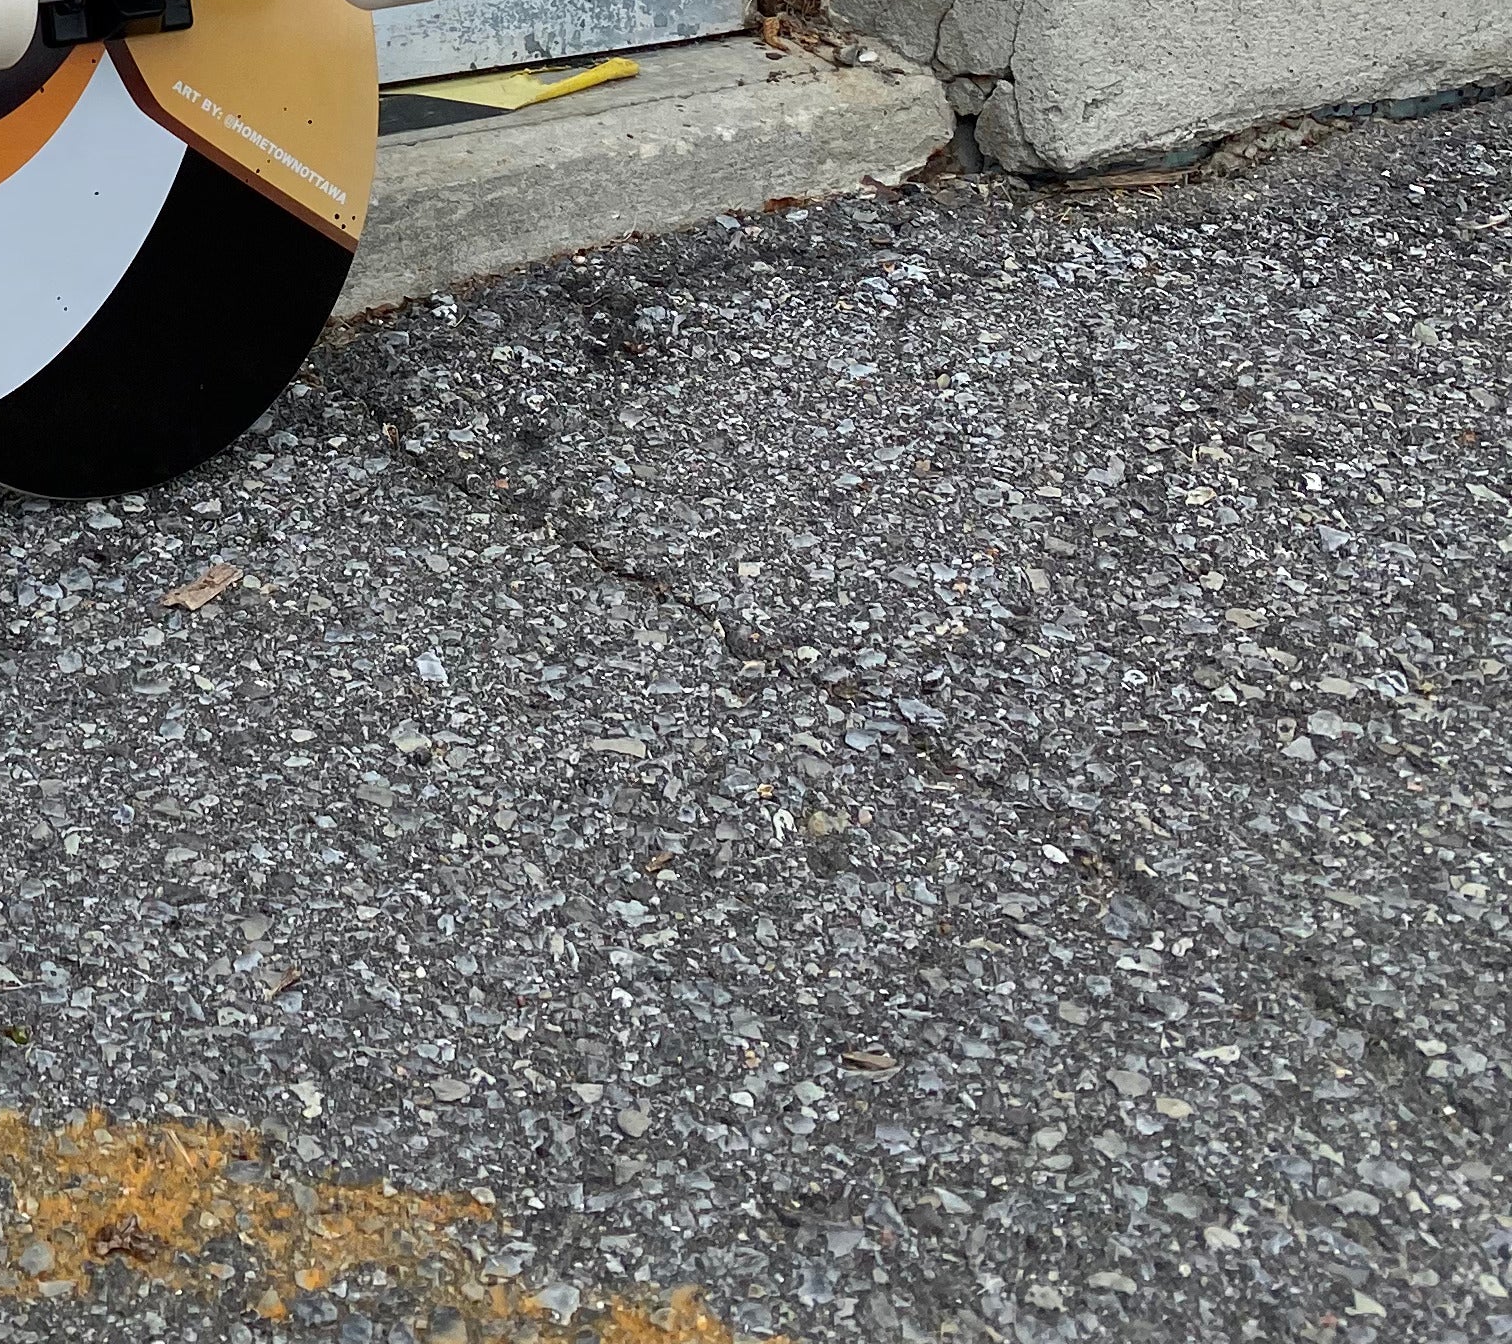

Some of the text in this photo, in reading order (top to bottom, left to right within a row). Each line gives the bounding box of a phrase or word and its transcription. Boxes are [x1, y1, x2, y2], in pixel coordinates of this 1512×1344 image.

[171, 79, 348, 206] ART BY: @HOMETOWNOTTAWA
